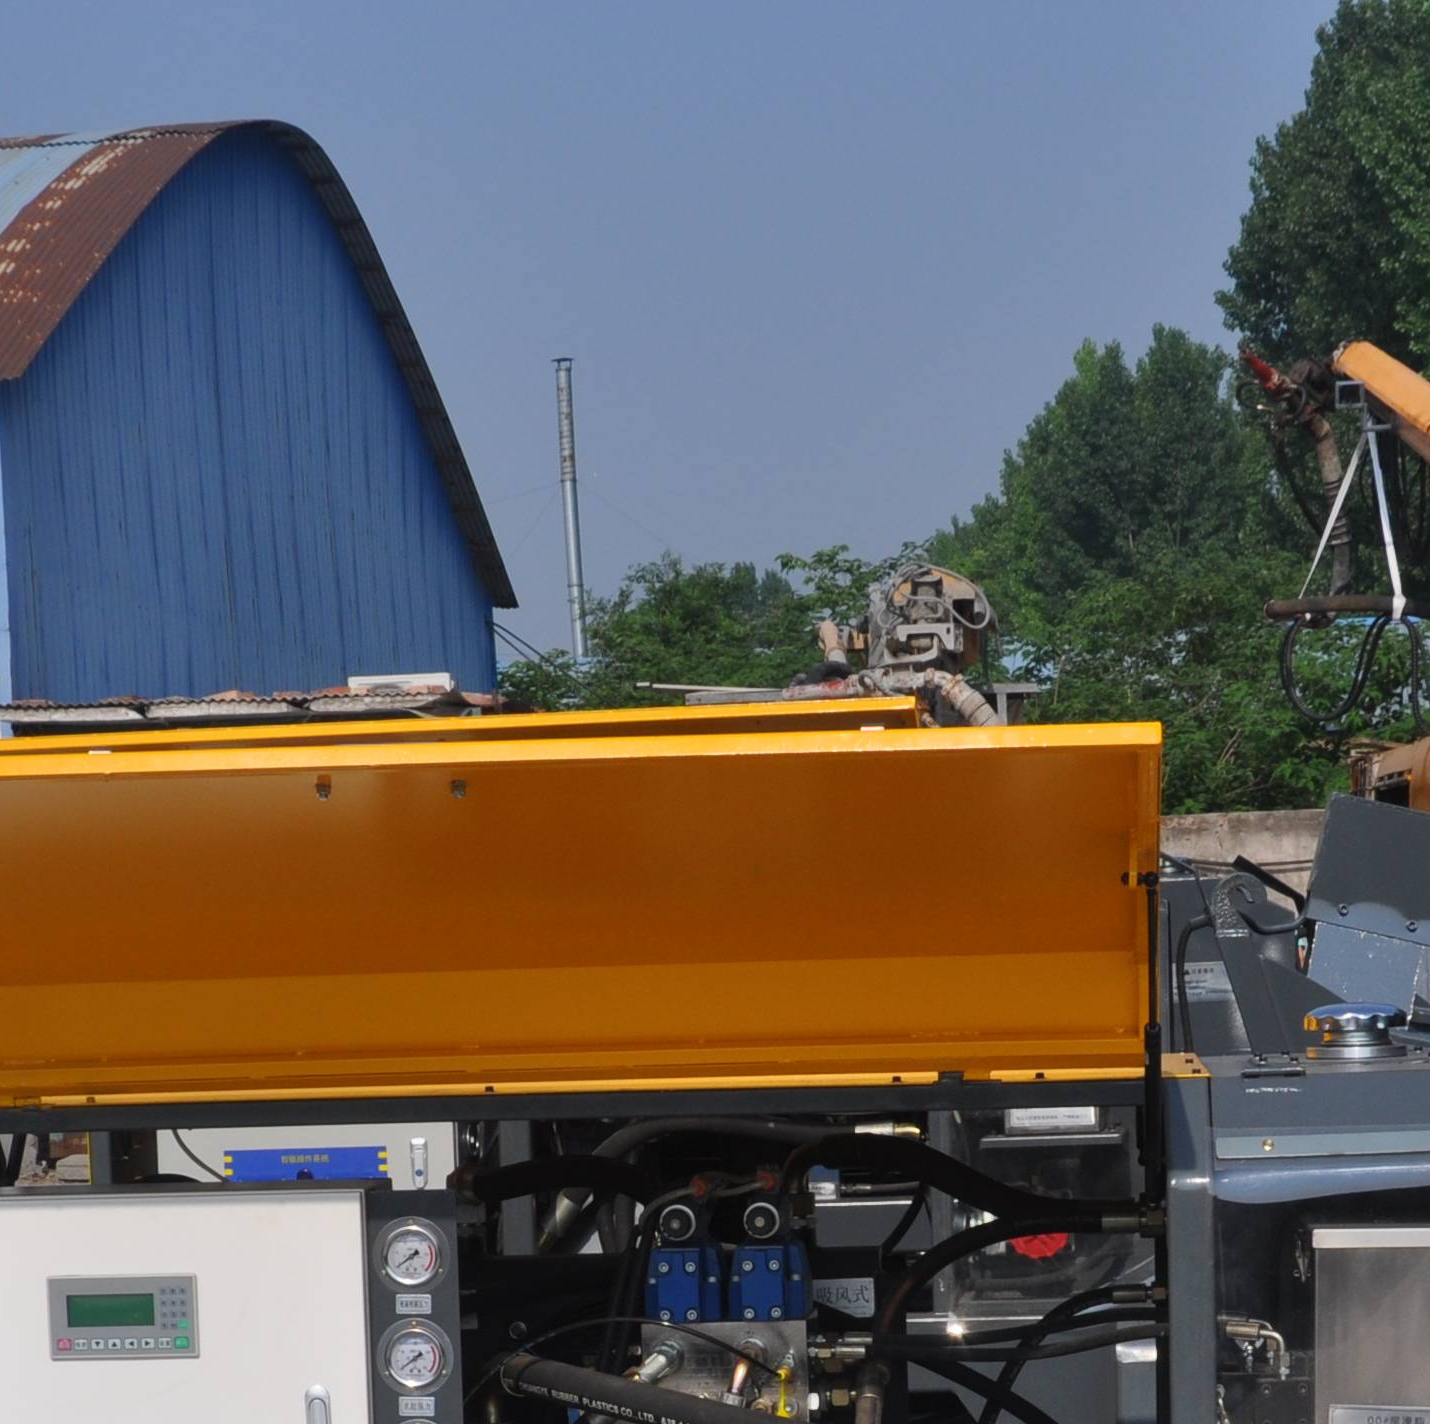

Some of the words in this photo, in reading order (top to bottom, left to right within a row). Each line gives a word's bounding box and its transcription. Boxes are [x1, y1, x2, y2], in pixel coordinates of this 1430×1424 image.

[816, 1285, 869, 1304] 吸风式
[551, 1389, 579, 1404] RUBBER
[582, 1398, 619, 1414] PLASTICS
